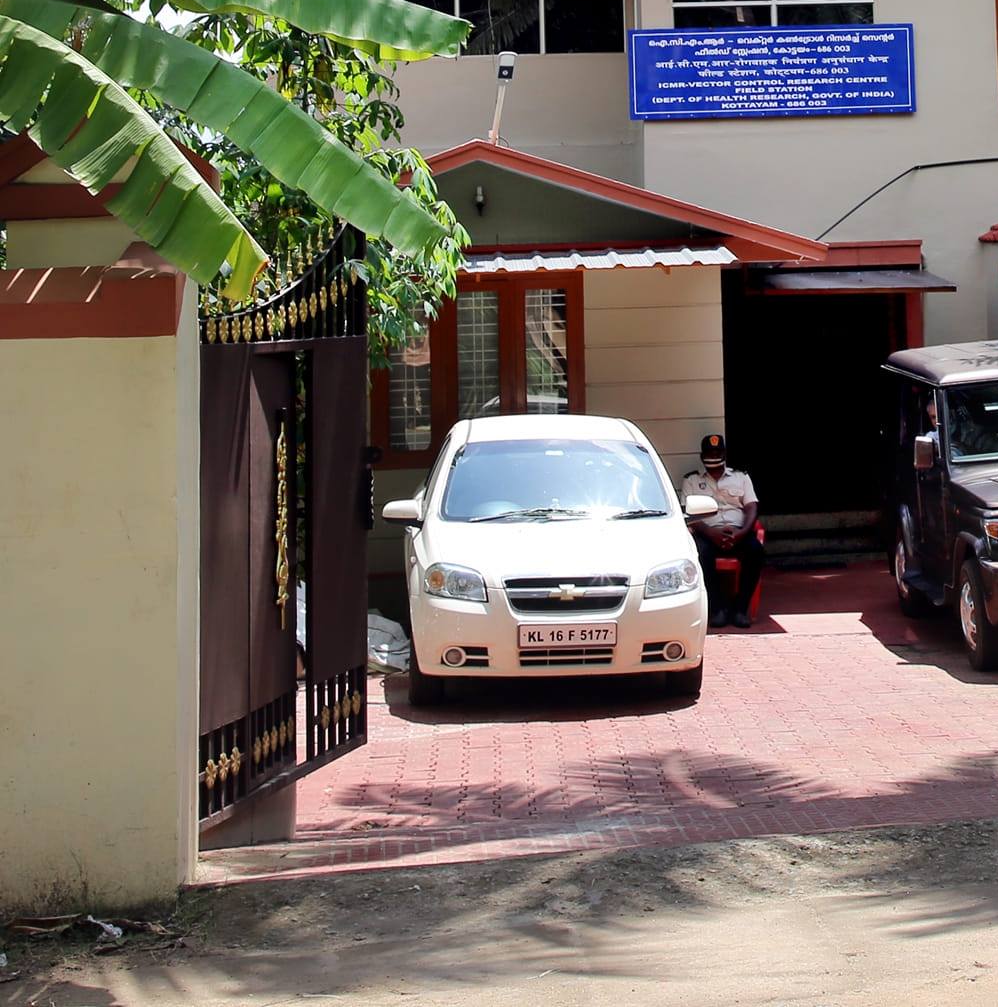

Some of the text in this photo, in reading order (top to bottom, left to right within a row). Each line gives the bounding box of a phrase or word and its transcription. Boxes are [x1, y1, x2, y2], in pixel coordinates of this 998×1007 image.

[787, 77, 843, 85] RESEARCH
[528, 629, 609, 642] KL 16 F 5177
